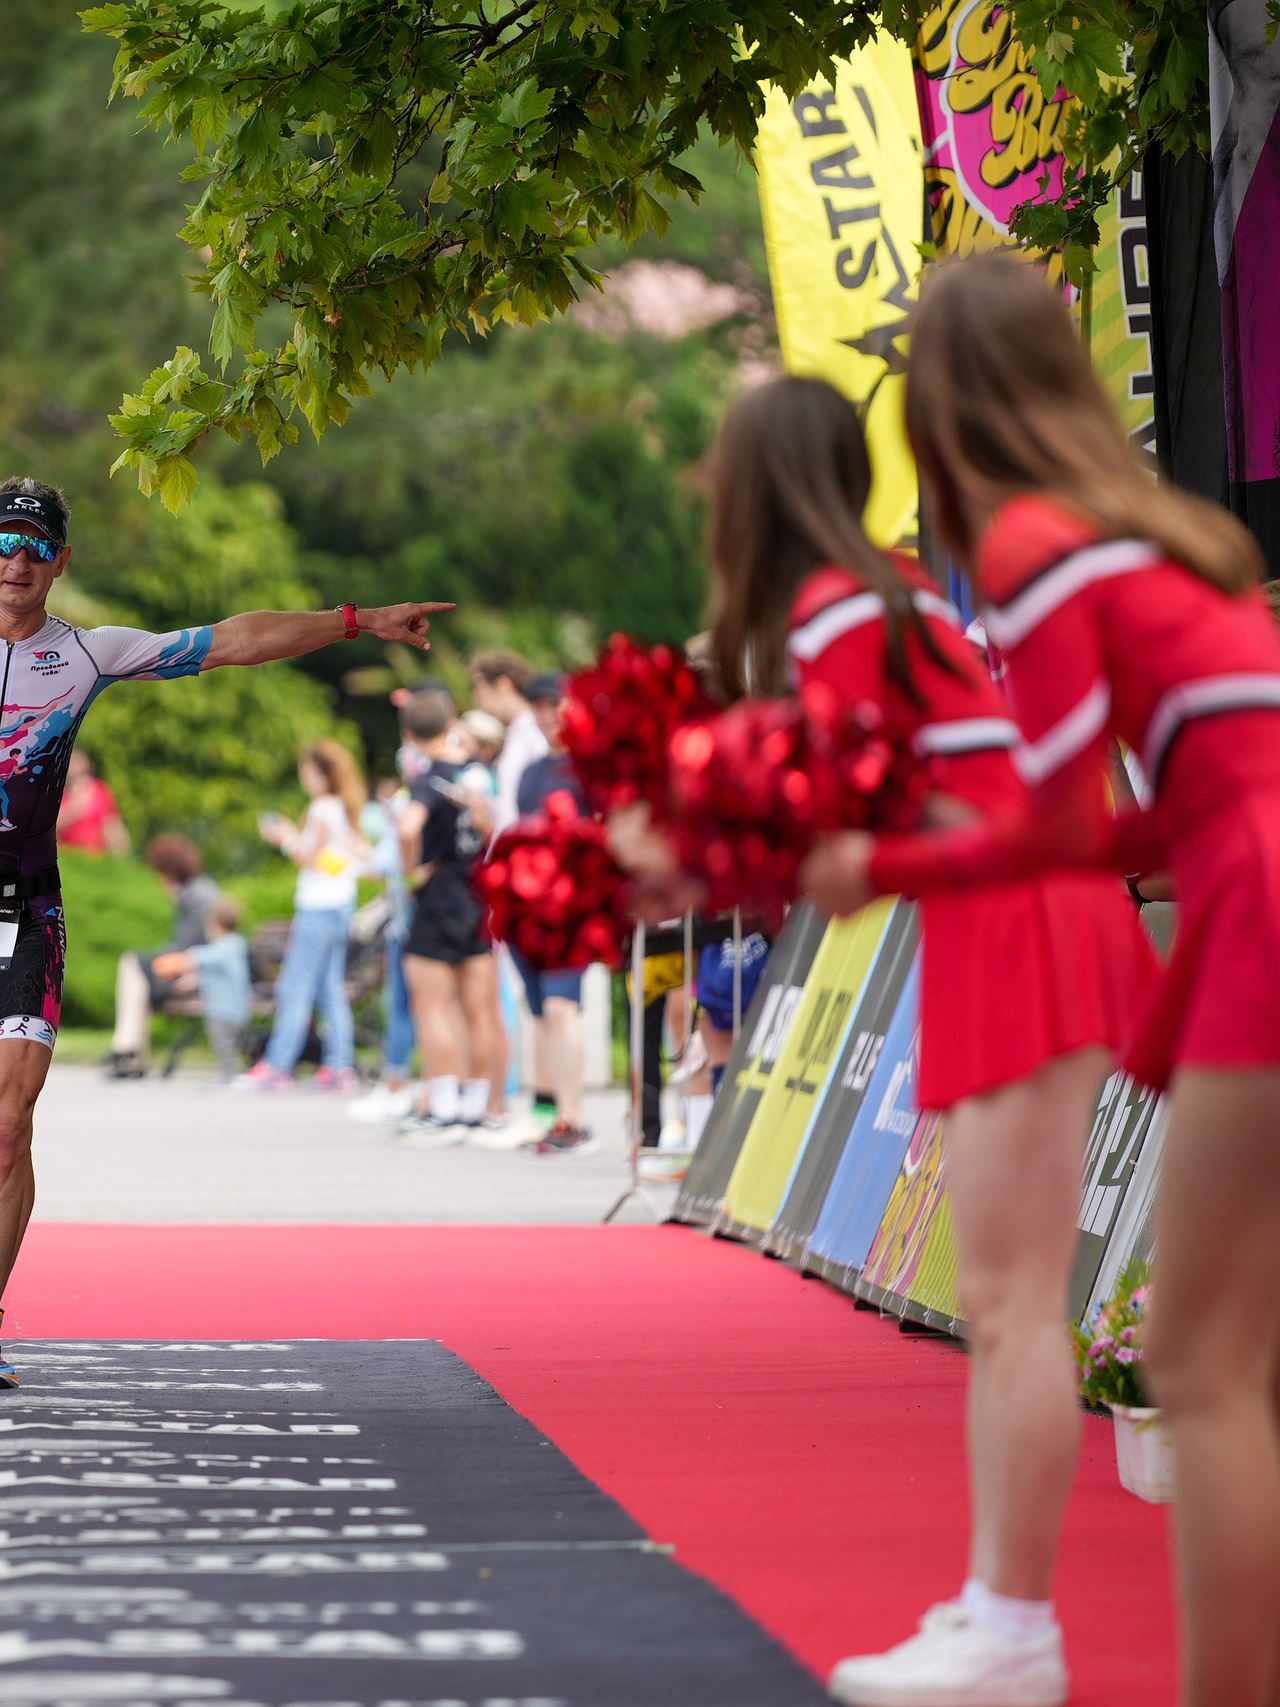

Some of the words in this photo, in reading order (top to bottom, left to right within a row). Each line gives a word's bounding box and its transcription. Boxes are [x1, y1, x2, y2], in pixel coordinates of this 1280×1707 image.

[793, 89, 880, 290] STAR
[6, 504, 46, 516] OAKLEY
[30, 660, 69, 672] Преодолей
[71, 1419, 361, 1435] STAR
[81, 1471, 397, 1489] STAR
